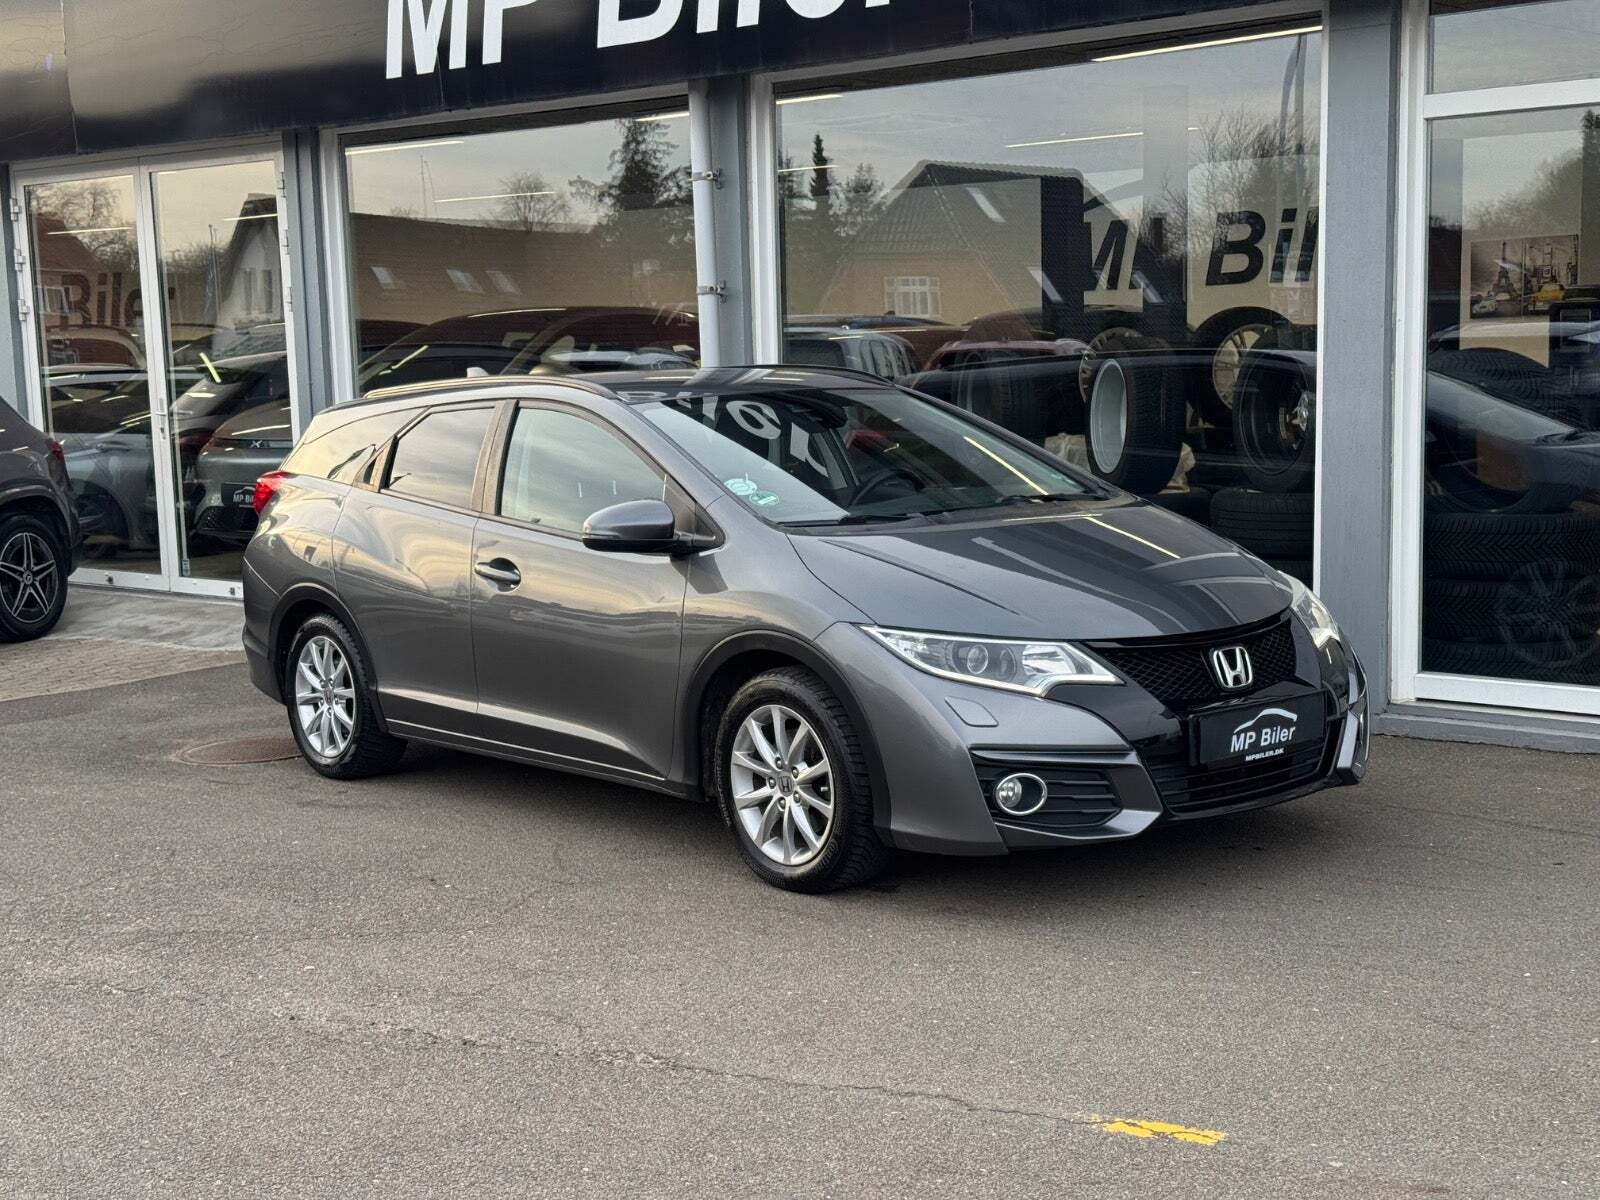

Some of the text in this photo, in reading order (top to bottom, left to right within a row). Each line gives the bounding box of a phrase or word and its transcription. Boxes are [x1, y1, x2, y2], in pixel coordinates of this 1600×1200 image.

[1230, 725, 1297, 753] MP Biler
[1245, 748, 1284, 761] MPBILER.DK
